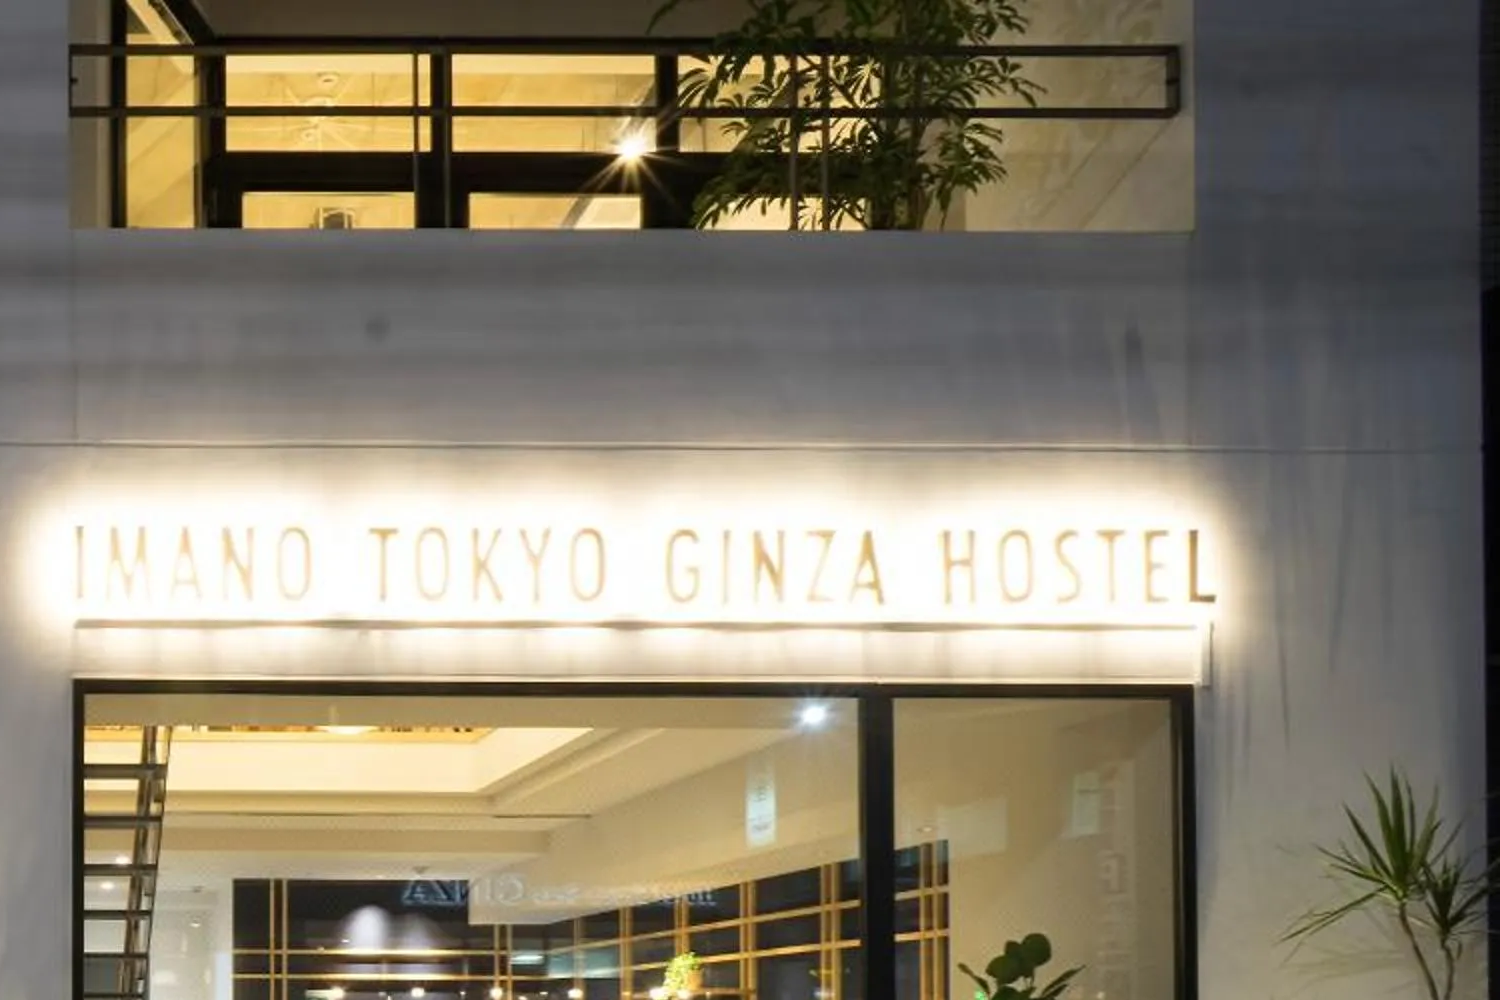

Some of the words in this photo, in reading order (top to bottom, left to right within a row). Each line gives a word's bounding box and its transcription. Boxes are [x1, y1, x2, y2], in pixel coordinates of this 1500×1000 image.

[75, 525, 312, 602] IMANO
[368, 526, 606, 602] TOKYO
[664, 528, 885, 605] GINZA
[939, 528, 1217, 604] HOSTEL
